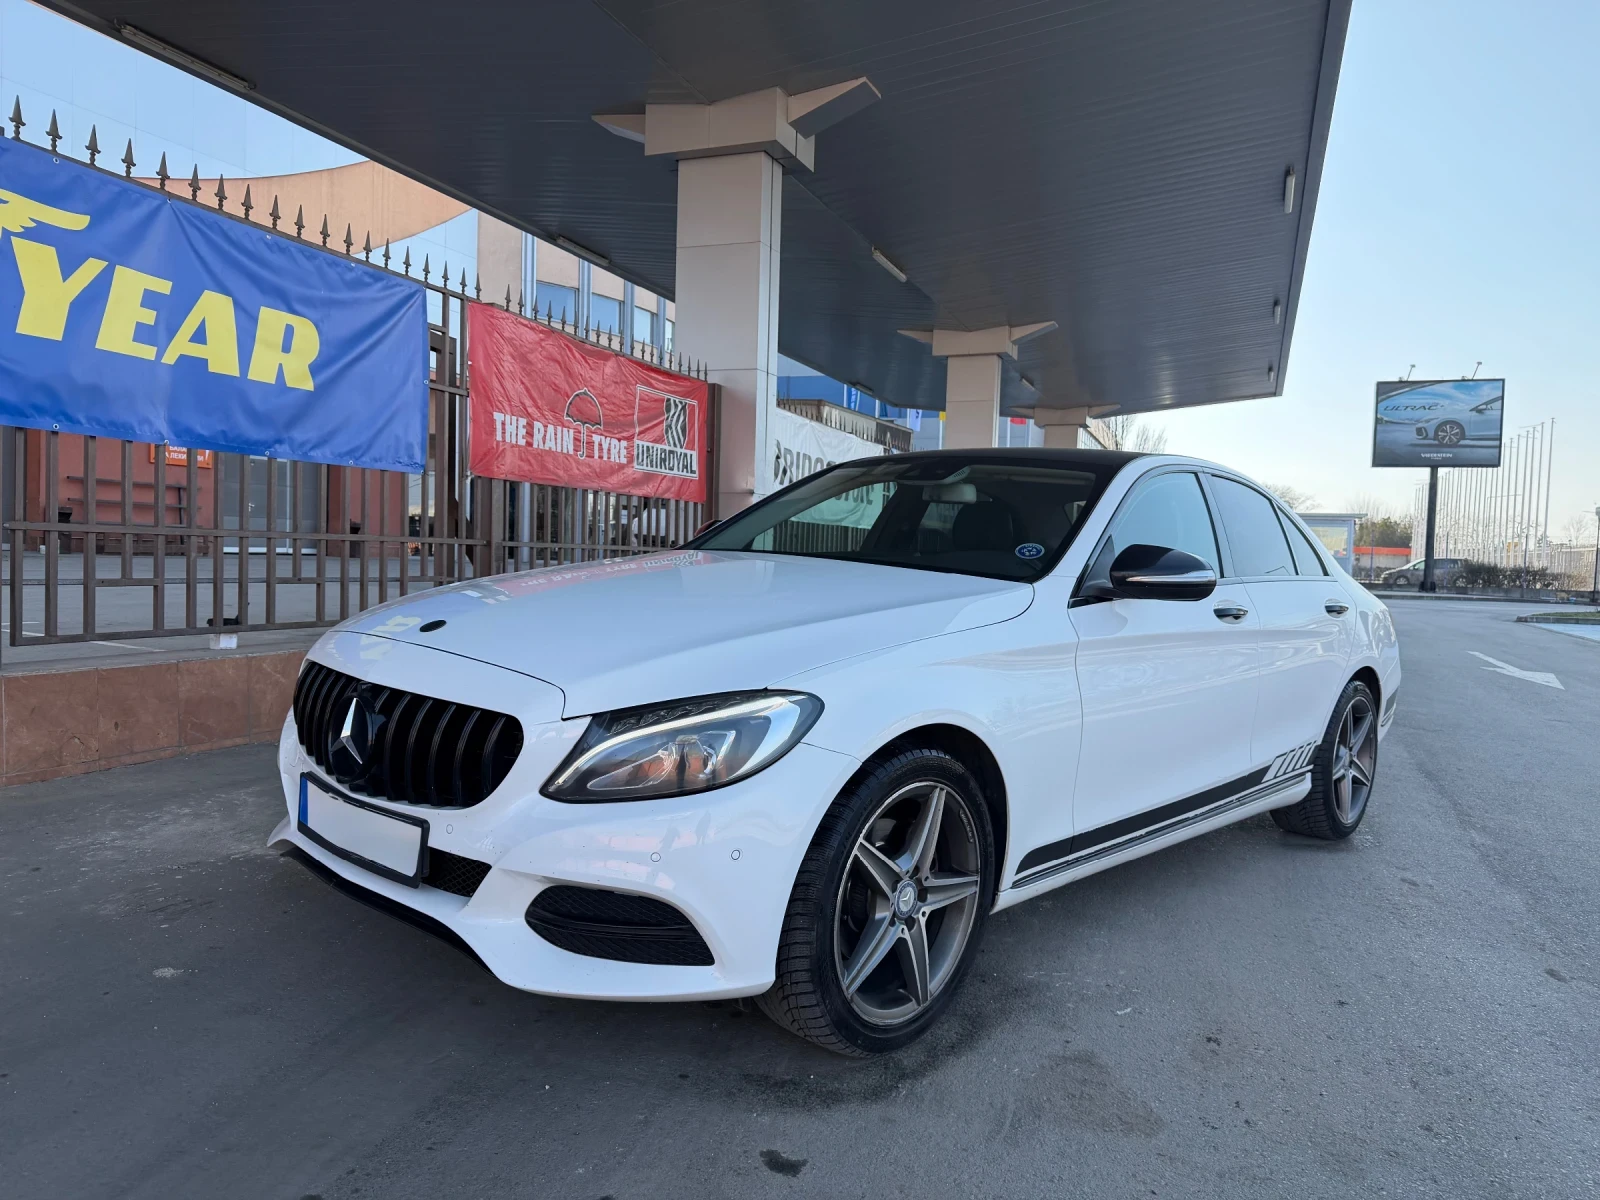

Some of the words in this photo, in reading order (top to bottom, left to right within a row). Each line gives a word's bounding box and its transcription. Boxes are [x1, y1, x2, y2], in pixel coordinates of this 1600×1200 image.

[11, 236, 320, 391] YEAR
[494, 412, 527, 445] THE
[534, 421, 575, 455] RAIN
[593, 435, 627, 464] TYRE
[636, 443, 697, 475] UNIROYAL
